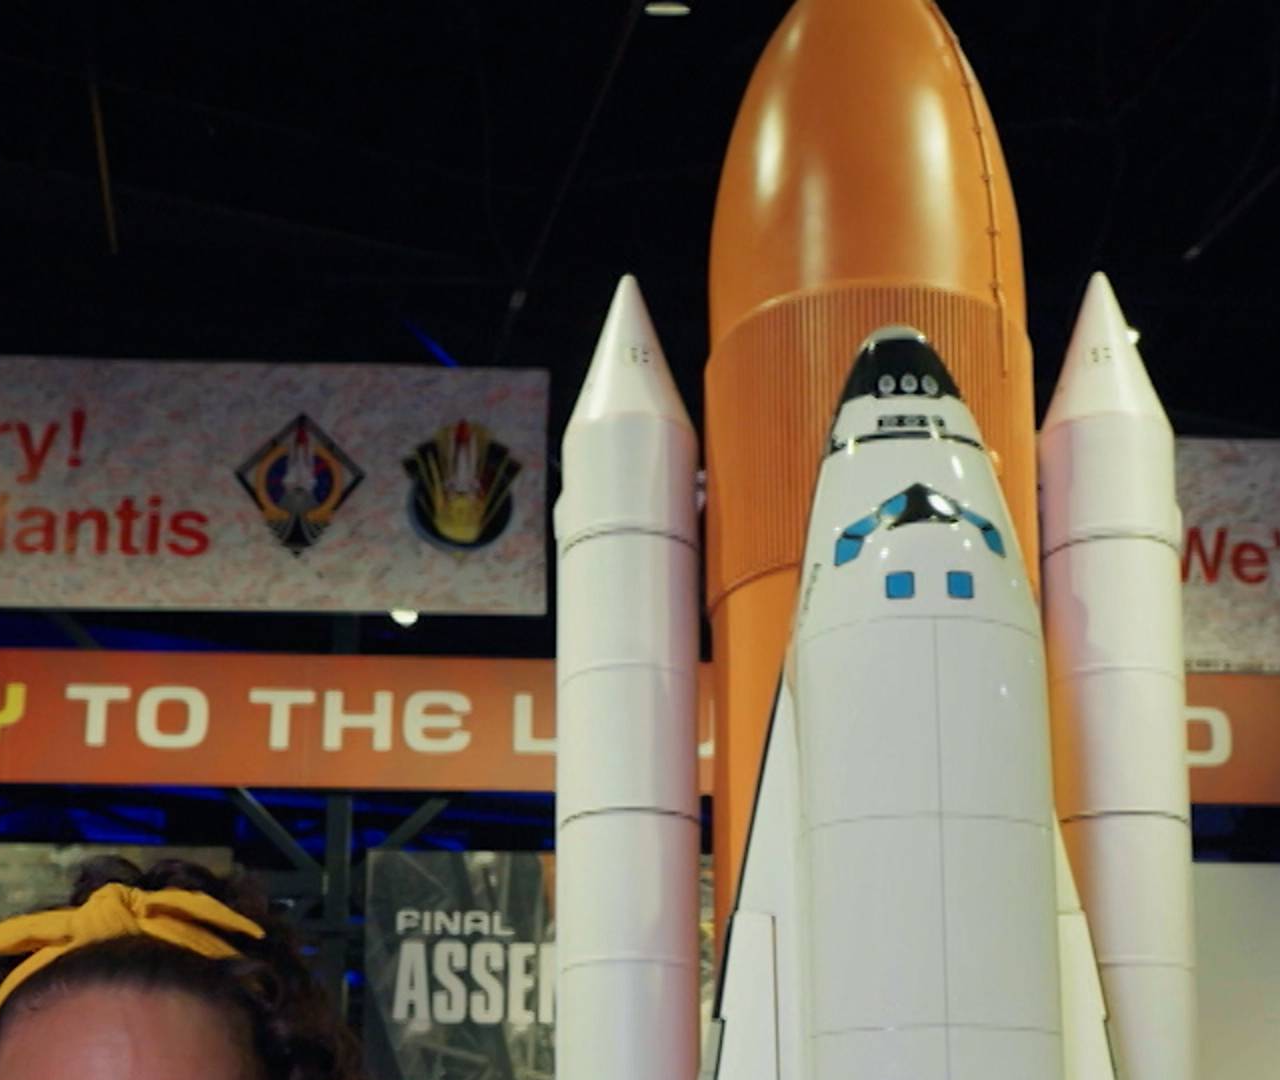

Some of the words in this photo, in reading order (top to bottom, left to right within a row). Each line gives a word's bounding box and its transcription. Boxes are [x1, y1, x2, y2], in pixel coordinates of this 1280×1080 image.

[66, 684, 210, 749] TO
[249, 688, 473, 755] THE
[395, 908, 516, 936] FINAL
